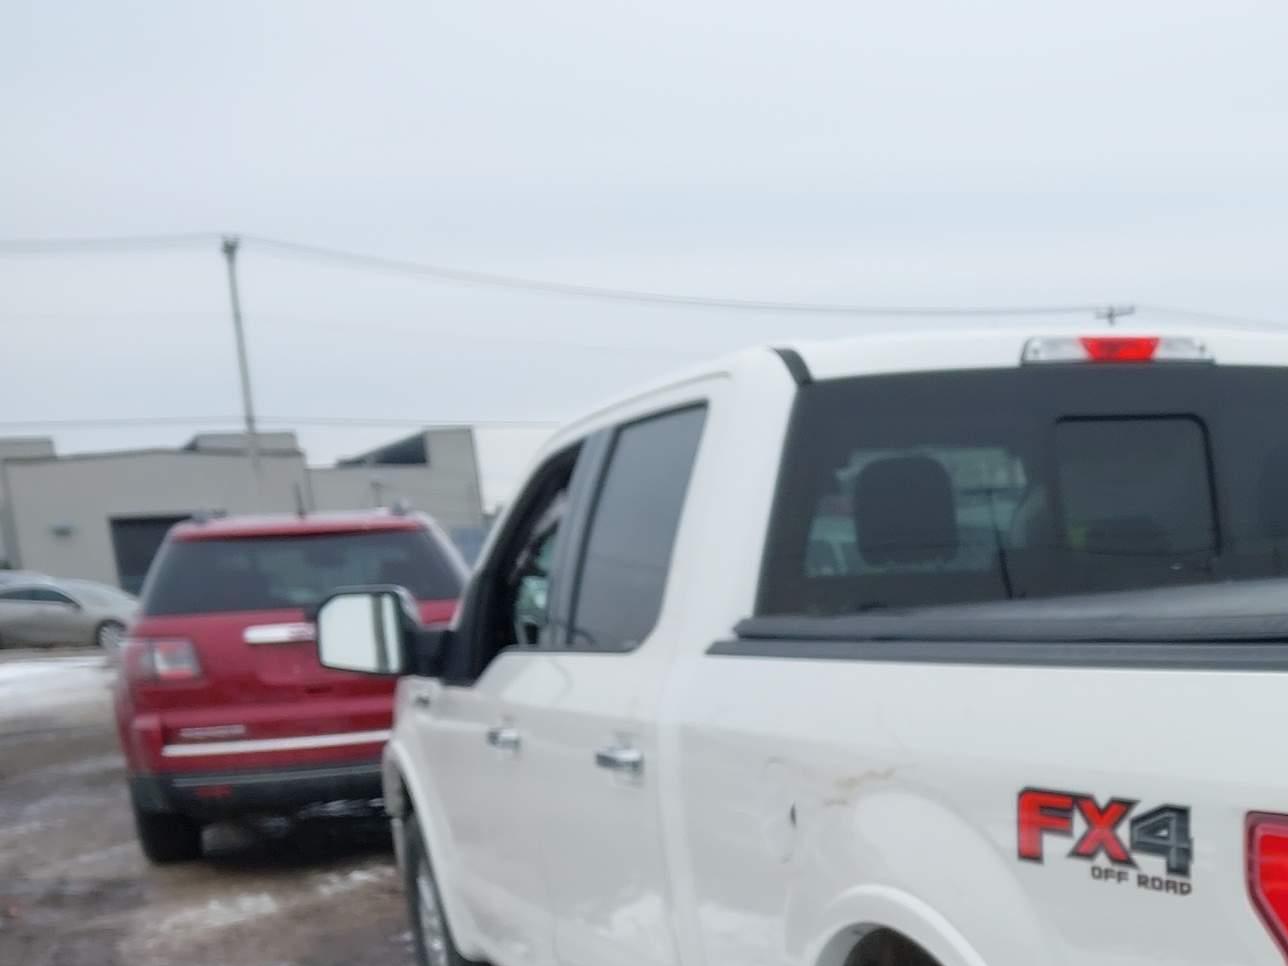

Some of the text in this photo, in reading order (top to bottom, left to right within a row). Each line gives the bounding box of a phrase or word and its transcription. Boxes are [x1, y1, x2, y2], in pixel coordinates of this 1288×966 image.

[1017, 786, 1194, 878] FX4
[1090, 865, 1192, 896] OFF ROAD
